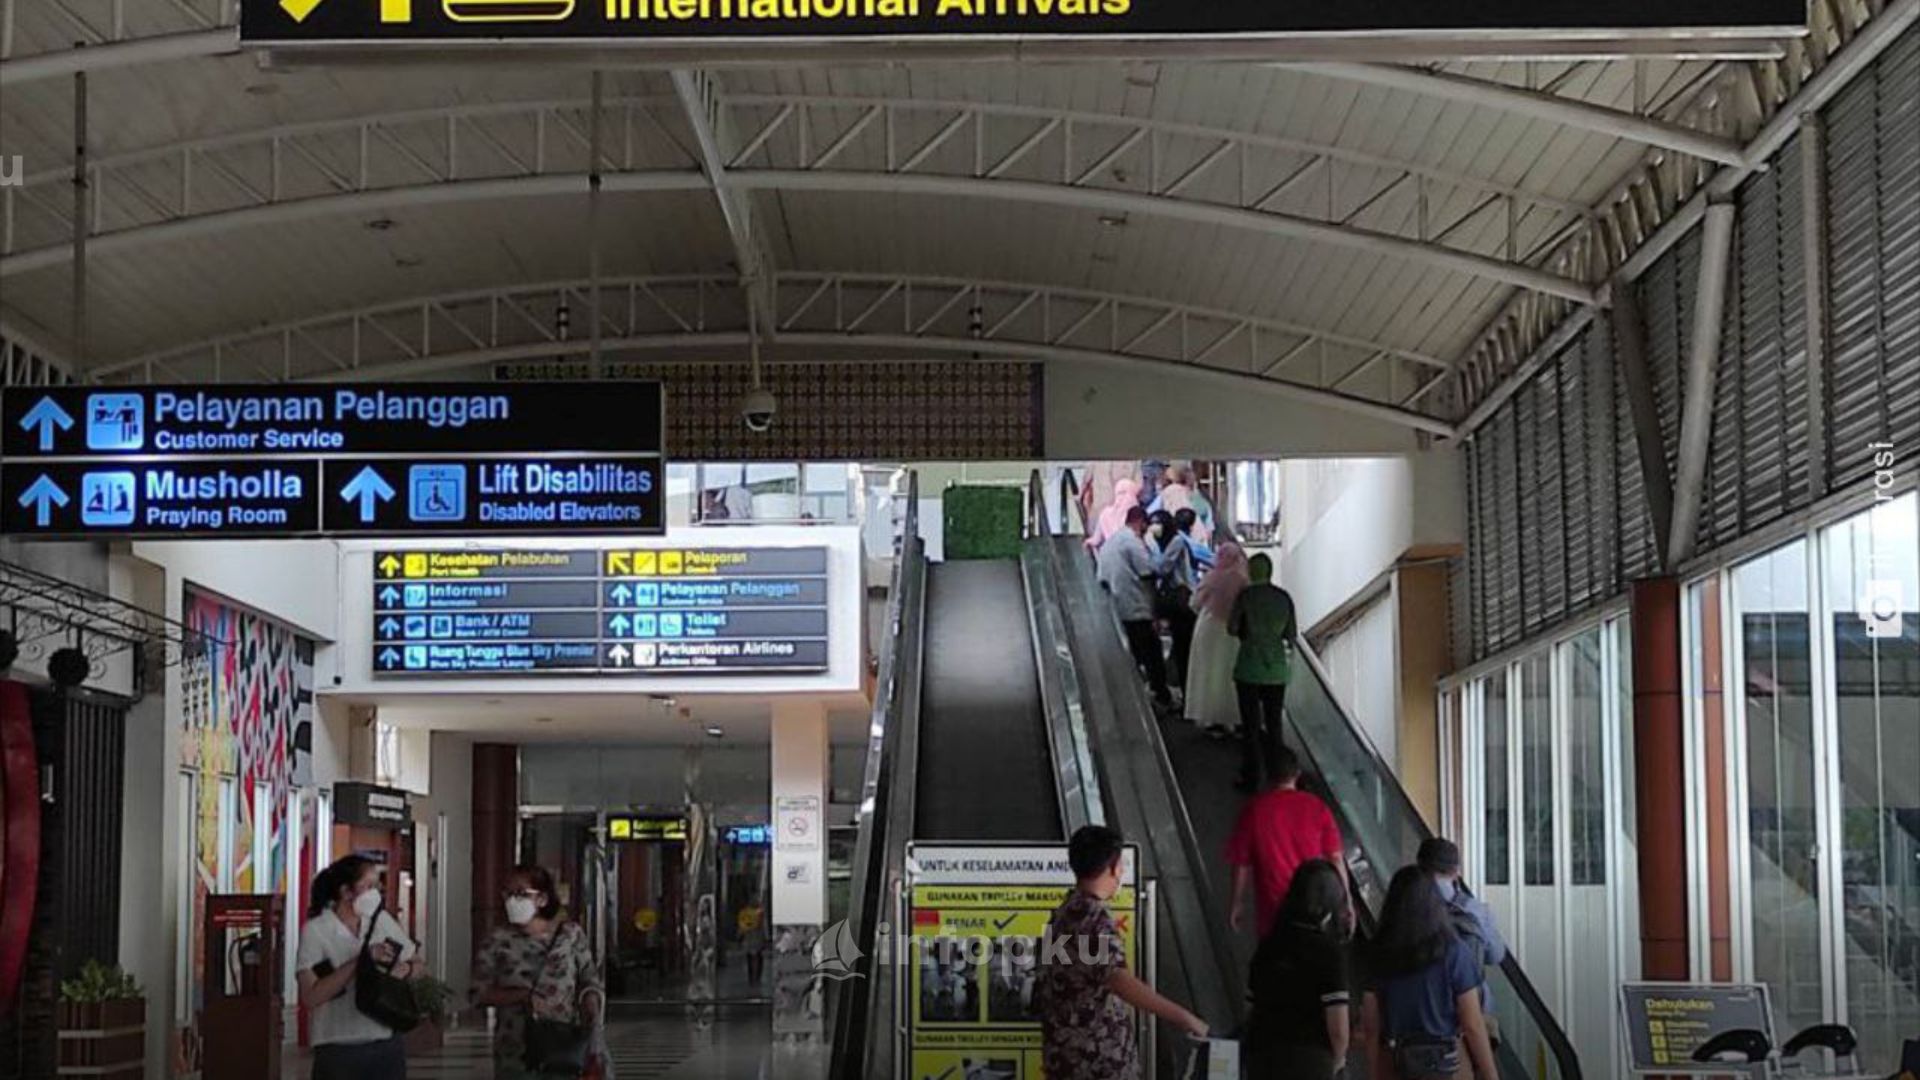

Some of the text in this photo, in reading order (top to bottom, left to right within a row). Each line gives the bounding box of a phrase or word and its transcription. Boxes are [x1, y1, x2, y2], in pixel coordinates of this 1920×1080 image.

[155, 390, 509, 429] Pelayanan Pelanggan
[155, 428, 344, 448] Customer Service
[146, 469, 302, 499] Musholla
[479, 463, 652, 493] Lift Disabilitas
[147, 506, 287, 528] Praying Room
[479, 501, 641, 521] Disabled Elevators
[430, 552, 569, 566] Kesehatan Pelabuhan
[685, 551, 746, 566] Pelaporan
[430, 584, 507, 597] Informasi
[661, 582, 800, 597] Pelayanan Pelanggan
[455, 615, 489, 627] Bank
[501, 614, 530, 627] ATM
[685, 613, 726, 626] Toilet
[430, 645, 464, 659] Ruang
[506, 644, 530, 657] Blue
[532, 644, 552, 660] Sky
[660, 642, 794, 656] Perkantoran Airlines
[921, 859, 1069, 872] UNTUK KESELAMATAN AND
[927, 891, 977, 902] GUNAKAN
